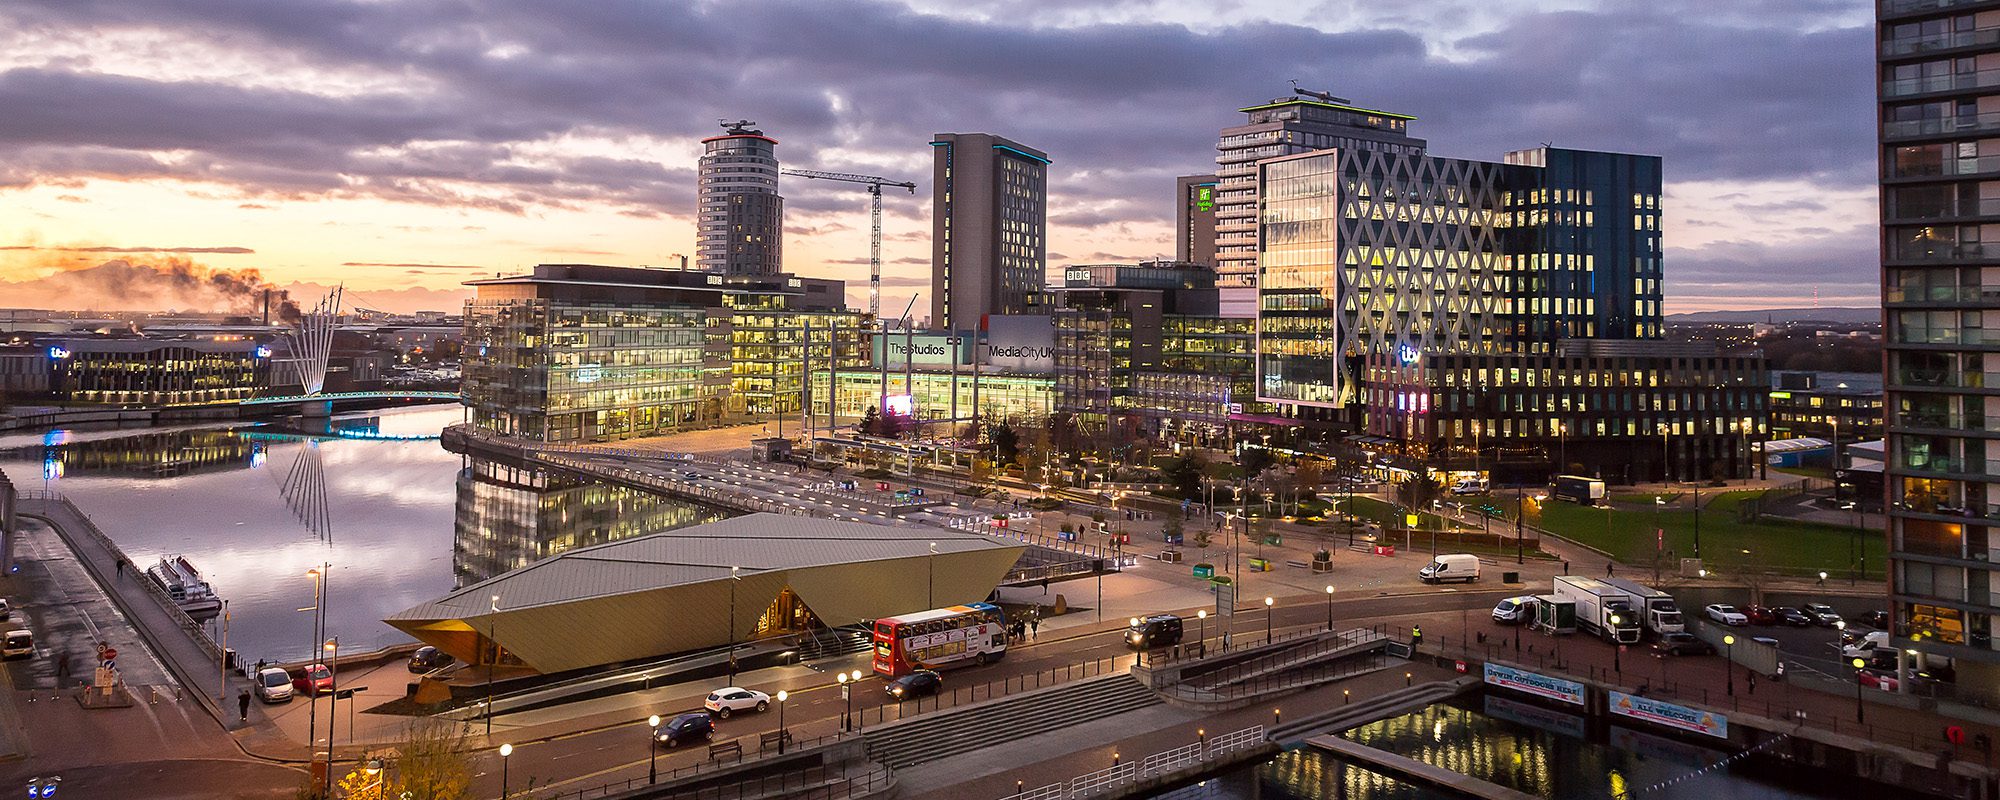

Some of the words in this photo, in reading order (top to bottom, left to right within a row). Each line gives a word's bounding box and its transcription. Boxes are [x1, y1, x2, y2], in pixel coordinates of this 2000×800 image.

[1068, 271, 1089, 280] BBC
[51, 347, 70, 358] itv
[989, 346, 1055, 361] MediaCityUK
[1402, 345, 1421, 362] itv
[1637, 704, 1653, 713] ALL
[1655, 707, 1697, 723] WELCOME
